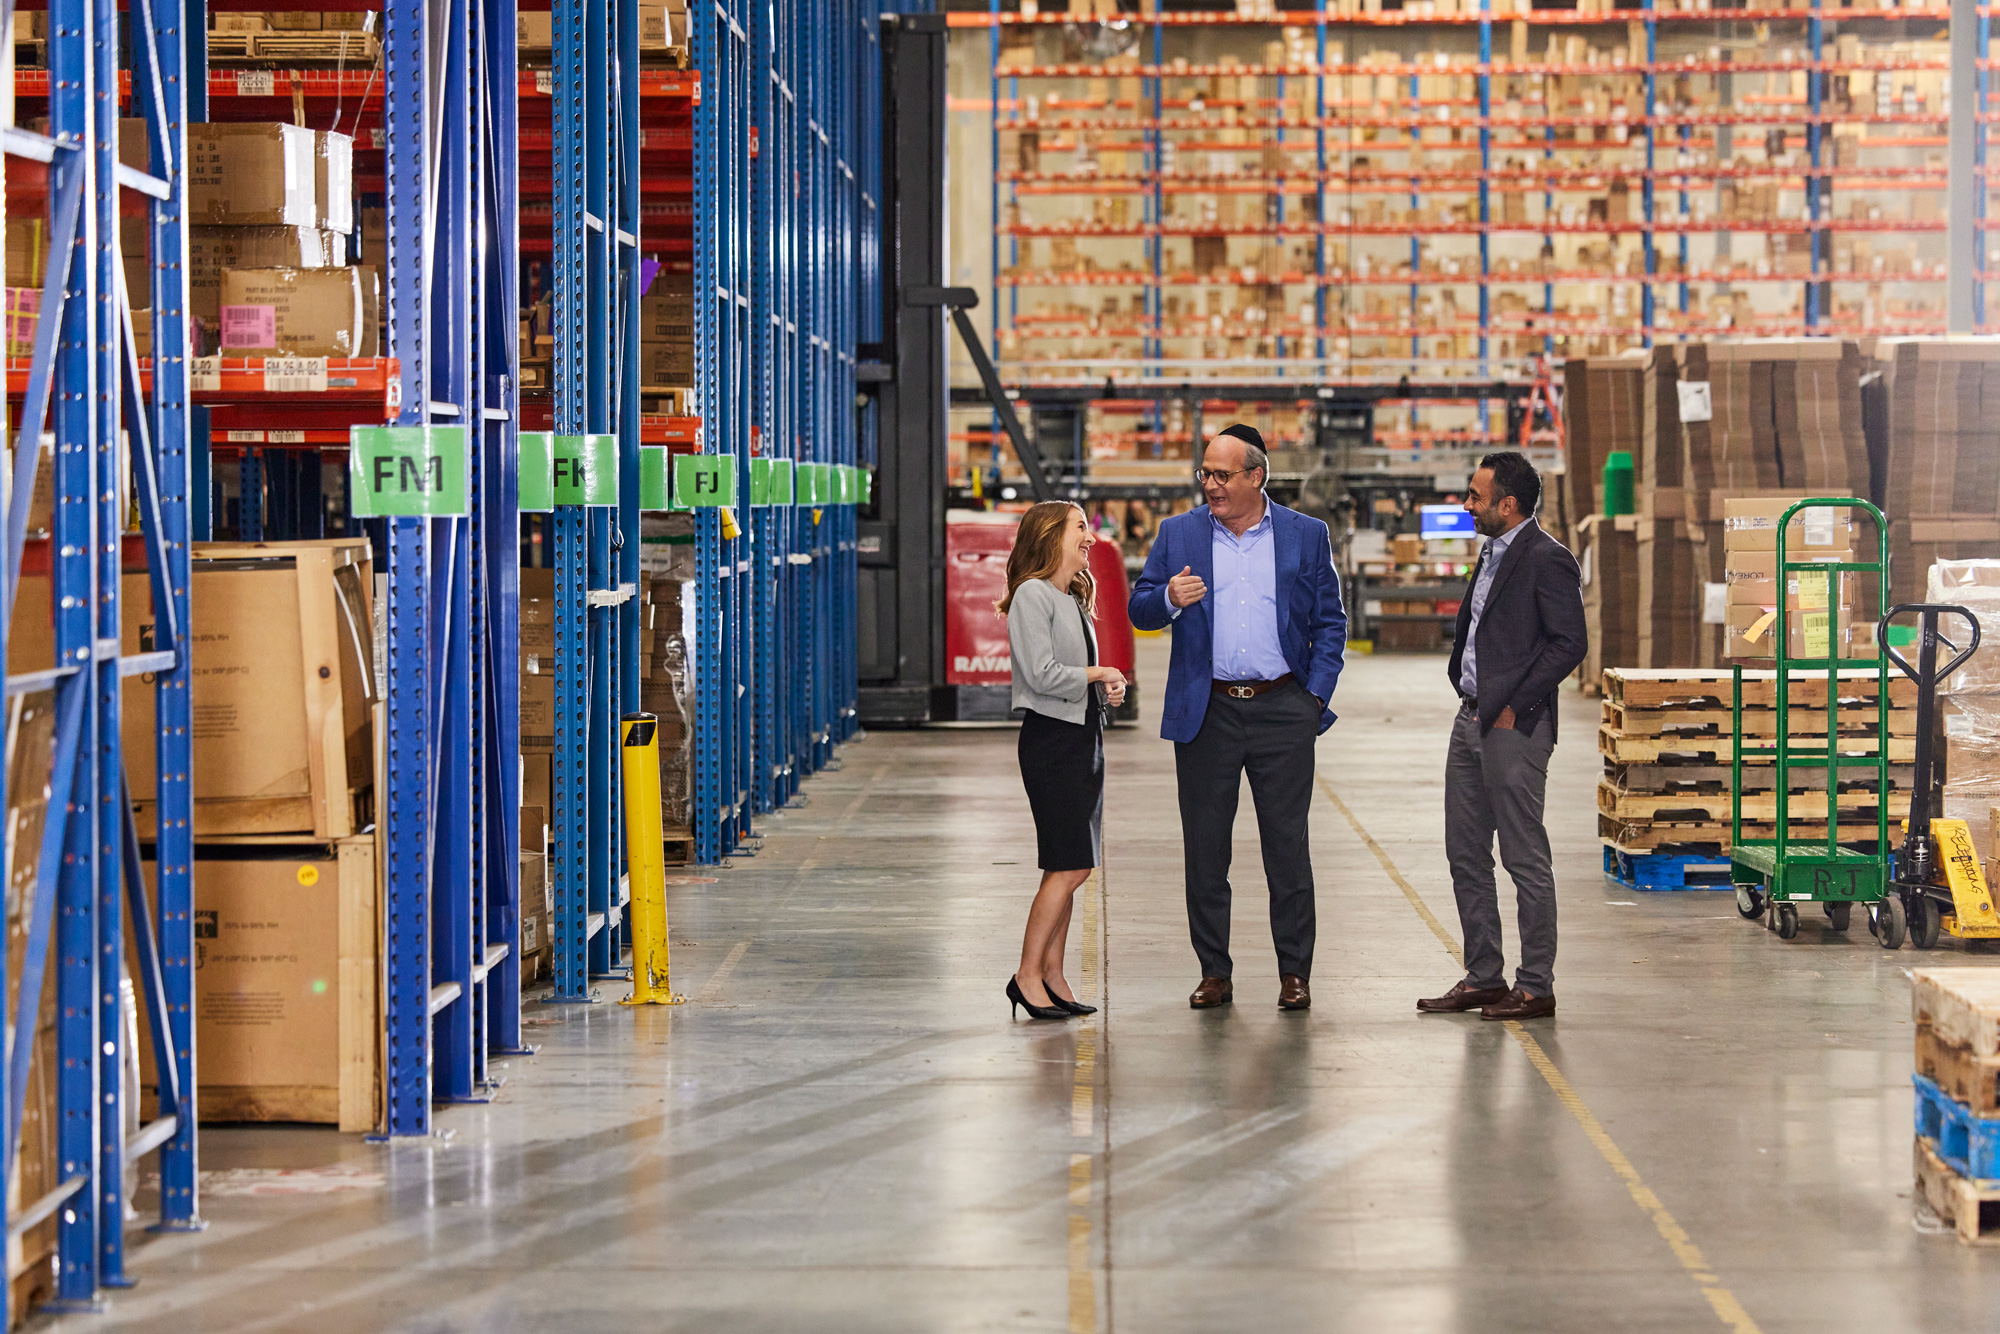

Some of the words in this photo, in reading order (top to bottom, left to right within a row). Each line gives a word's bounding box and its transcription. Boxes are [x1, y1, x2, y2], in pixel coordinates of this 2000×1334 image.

[374, 456, 443, 493] FM
[554, 458, 586, 488] FK
[695, 472, 718, 493] FJ
[1814, 868, 1832, 896] R
[1841, 869, 1863, 896] J
